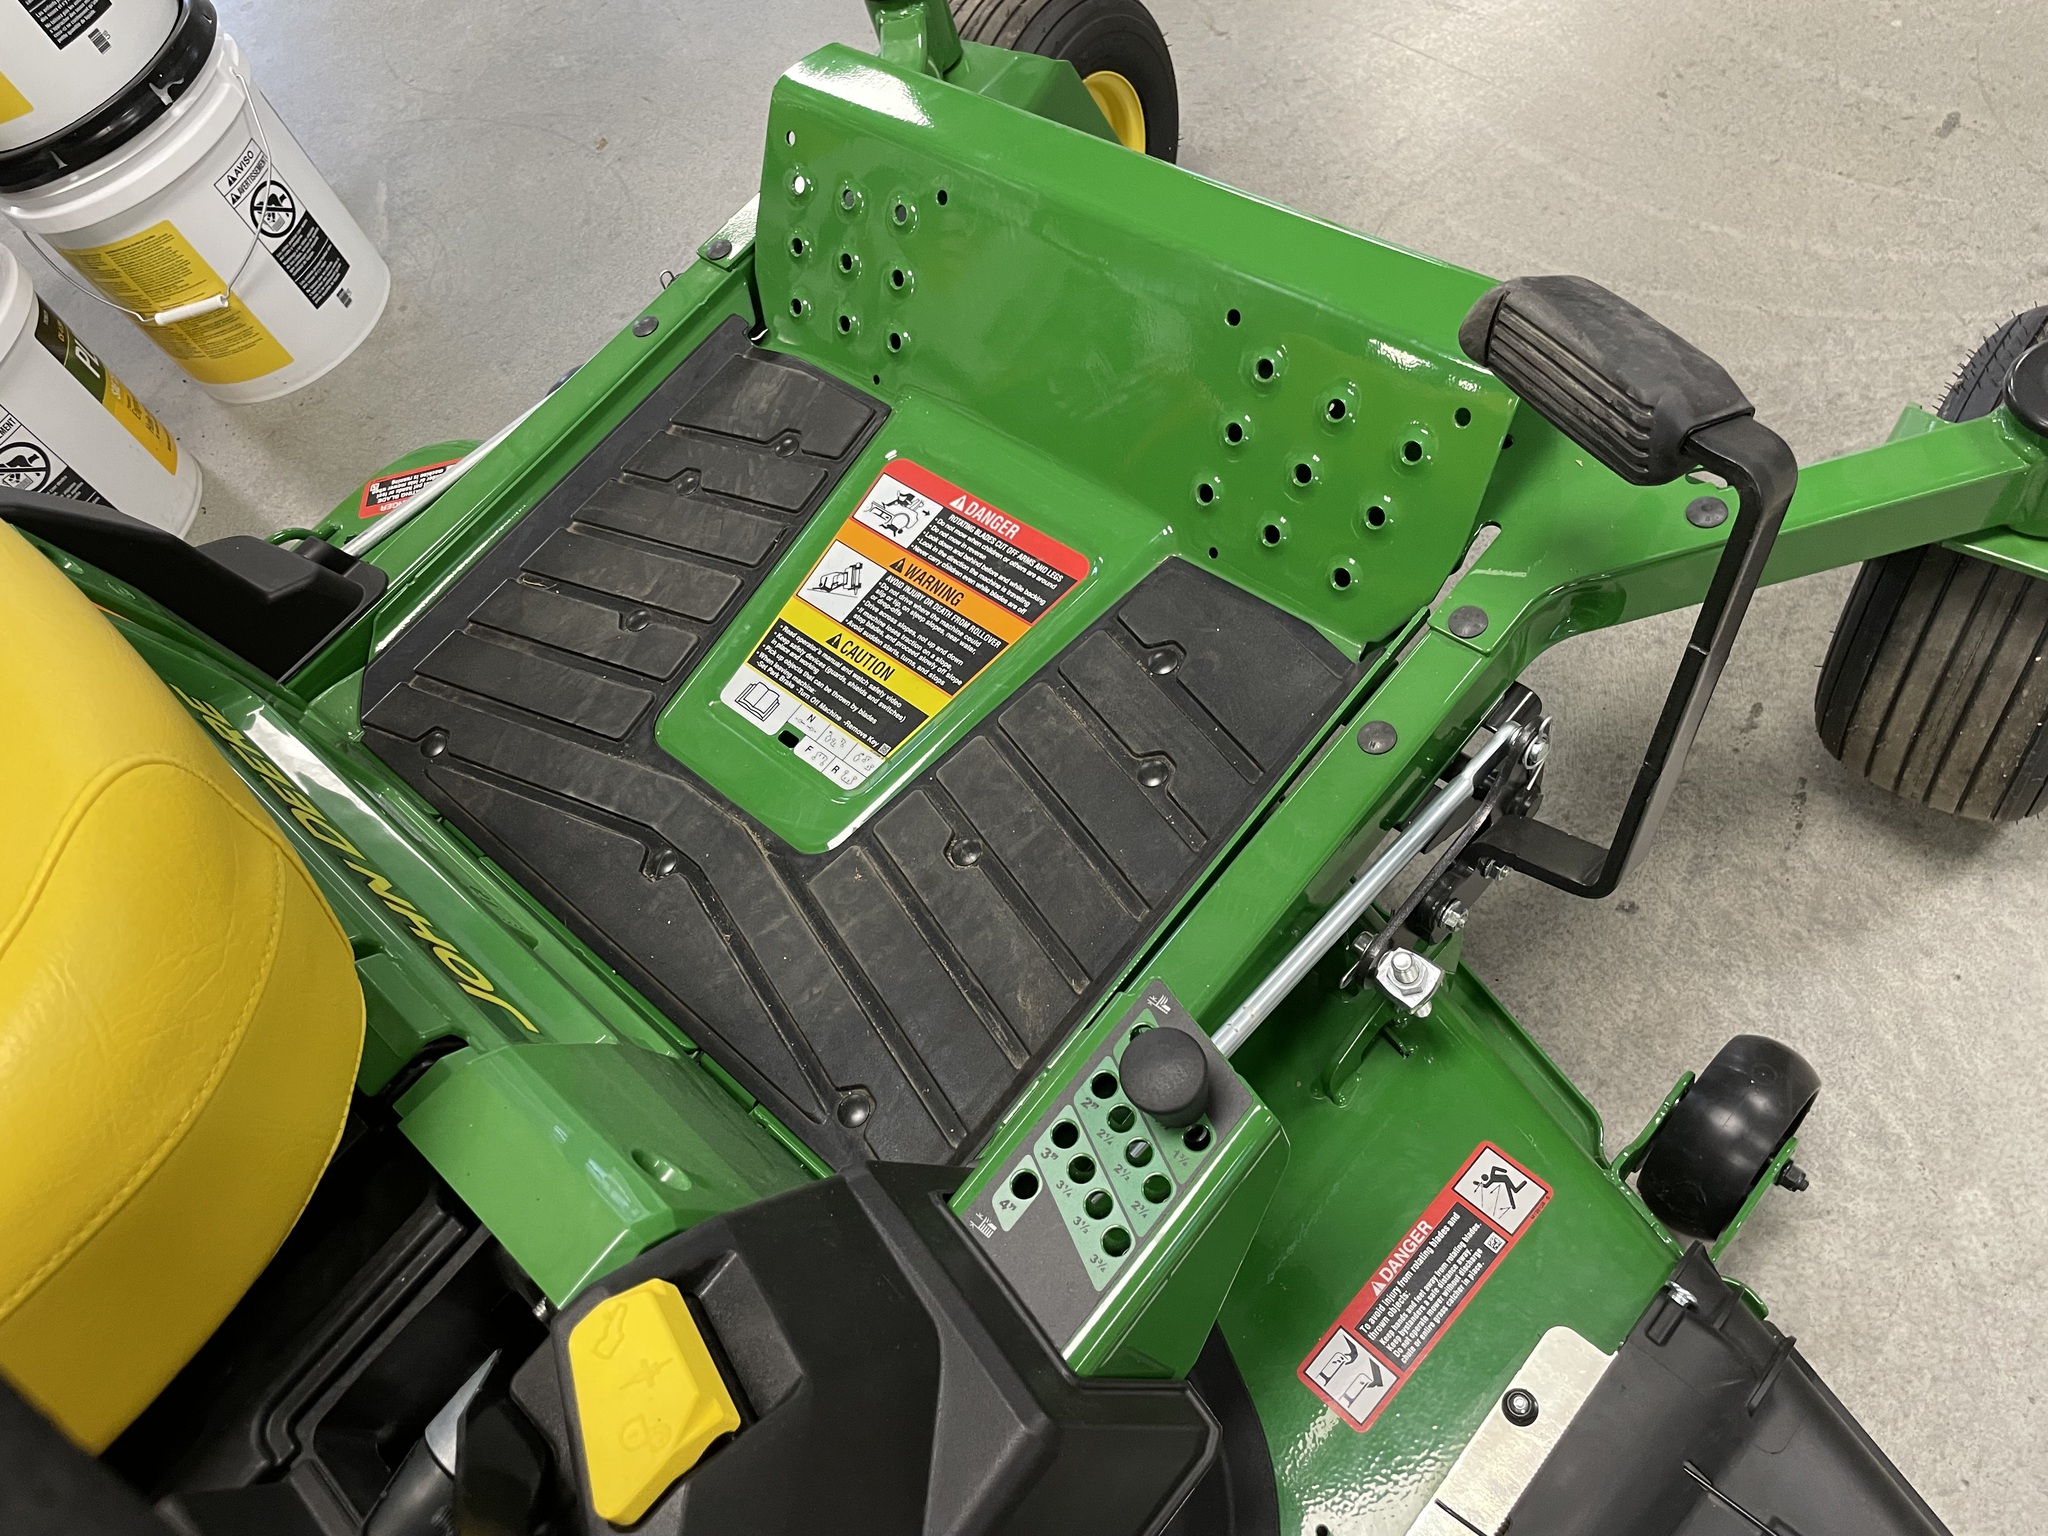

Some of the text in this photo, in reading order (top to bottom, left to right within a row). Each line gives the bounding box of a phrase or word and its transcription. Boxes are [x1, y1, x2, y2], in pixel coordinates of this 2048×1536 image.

[234, 150, 254, 178] AVISO
[938, 530, 949, 538] not
[947, 536, 960, 545] mow
[966, 547, 986, 559] reverse
[948, 514, 1063, 582] ROTATING BLADES CUT OFF ARMS AND LEGS
[963, 501, 1021, 539] DANGER
[903, 564, 965, 606] WARNING
[912, 545, 928, 556] Never
[926, 555, 941, 565] carry
[941, 562, 963, 576] children
[961, 575, 975, 584] even
[974, 582, 990, 593] while
[989, 590, 1008, 603] blades
[1016, 606, 1026, 614] off
[944, 523, 955, 531] not
[953, 529, 967, 538] mow
[966, 535, 982, 546] when
[981, 544, 1003, 558] children
[1008, 560, 1027, 572] others
[1035, 575, 1057, 589] around
[862, 610, 886, 627] machine
[885, 625, 901, 636] loses
[900, 634, 923, 650] traction
[863, 601, 879, 612] Drive
[878, 611, 897, 624] across
[916, 634, 928, 642] not
[935, 645, 948, 655] and
[946, 652, 964, 665] down
[873, 588, 886, 598] slip
[908, 610, 926, 623] steep
[945, 633, 958, 642] near
[885, 575, 1002, 647] AVOID INJURY OR DEATH FROM ROLLOVER
[888, 588, 899, 596] not
[898, 594, 913, 605] drive
[912, 602, 930, 615] where
[929, 613, 940, 621] the
[939, 619, 964, 636] machine
[963, 634, 981, 646] could
[758, 652, 774, 665] When
[771, 662, 793, 678] leaving
[774, 633, 790, 646] Keep
[788, 642, 806, 656] safety
[805, 652, 826, 668] devices
[847, 680, 868, 695] shields
[867, 693, 880, 703] and
[878, 700, 907, 721] switches)
[781, 626, 796, 638] Read
[821, 652, 842, 667] manual
[840, 665, 853, 674] and
[851, 672, 869, 685] watch
[867, 682, 886, 698] safety
[885, 694, 903, 707] video
[839, 640, 895, 680] CAUTION
[851, 613, 866, 624] stop
[884, 633, 896, 642] and
[894, 640, 919, 658] proceed
[917, 654, 937, 669] slowly
[936, 666, 946, 674] off
[944, 672, 963, 686] slope
[763, 645, 878, 723] Pick up objects that can be thrown by blades
[766, 667, 779, 678] Park
[778, 676, 795, 688] Brake
[809, 696, 820, 705] Off
[818, 702, 842, 720] Machine
[865, 735, 880, 747] Key
[806, 714, 816, 723] N
[831, 765, 840, 774] R
[169, 683, 539, 1033] JOHN DEERE
[1359, 1212, 1460, 1333] To avoid injury from rotating blades and
[1378, 1220, 1432, 1281] DANGER
[1379, 1328, 1395, 1346] Keep
[1391, 1311, 1408, 1330] hands
[1405, 1300, 1416, 1313] and
[1413, 1289, 1426, 1302] feet
[1424, 1276, 1439, 1292] away
[1434, 1261, 1448, 1276] from
[1445, 1240, 1466, 1264] rotating
[1386, 1334, 1402, 1352] Keep
[1398, 1304, 1427, 1337] bystanders
[1426, 1286, 1439, 1300] safe
[1436, 1263, 1458, 1288] distance
[1368, 1315, 1389, 1340] thrown
